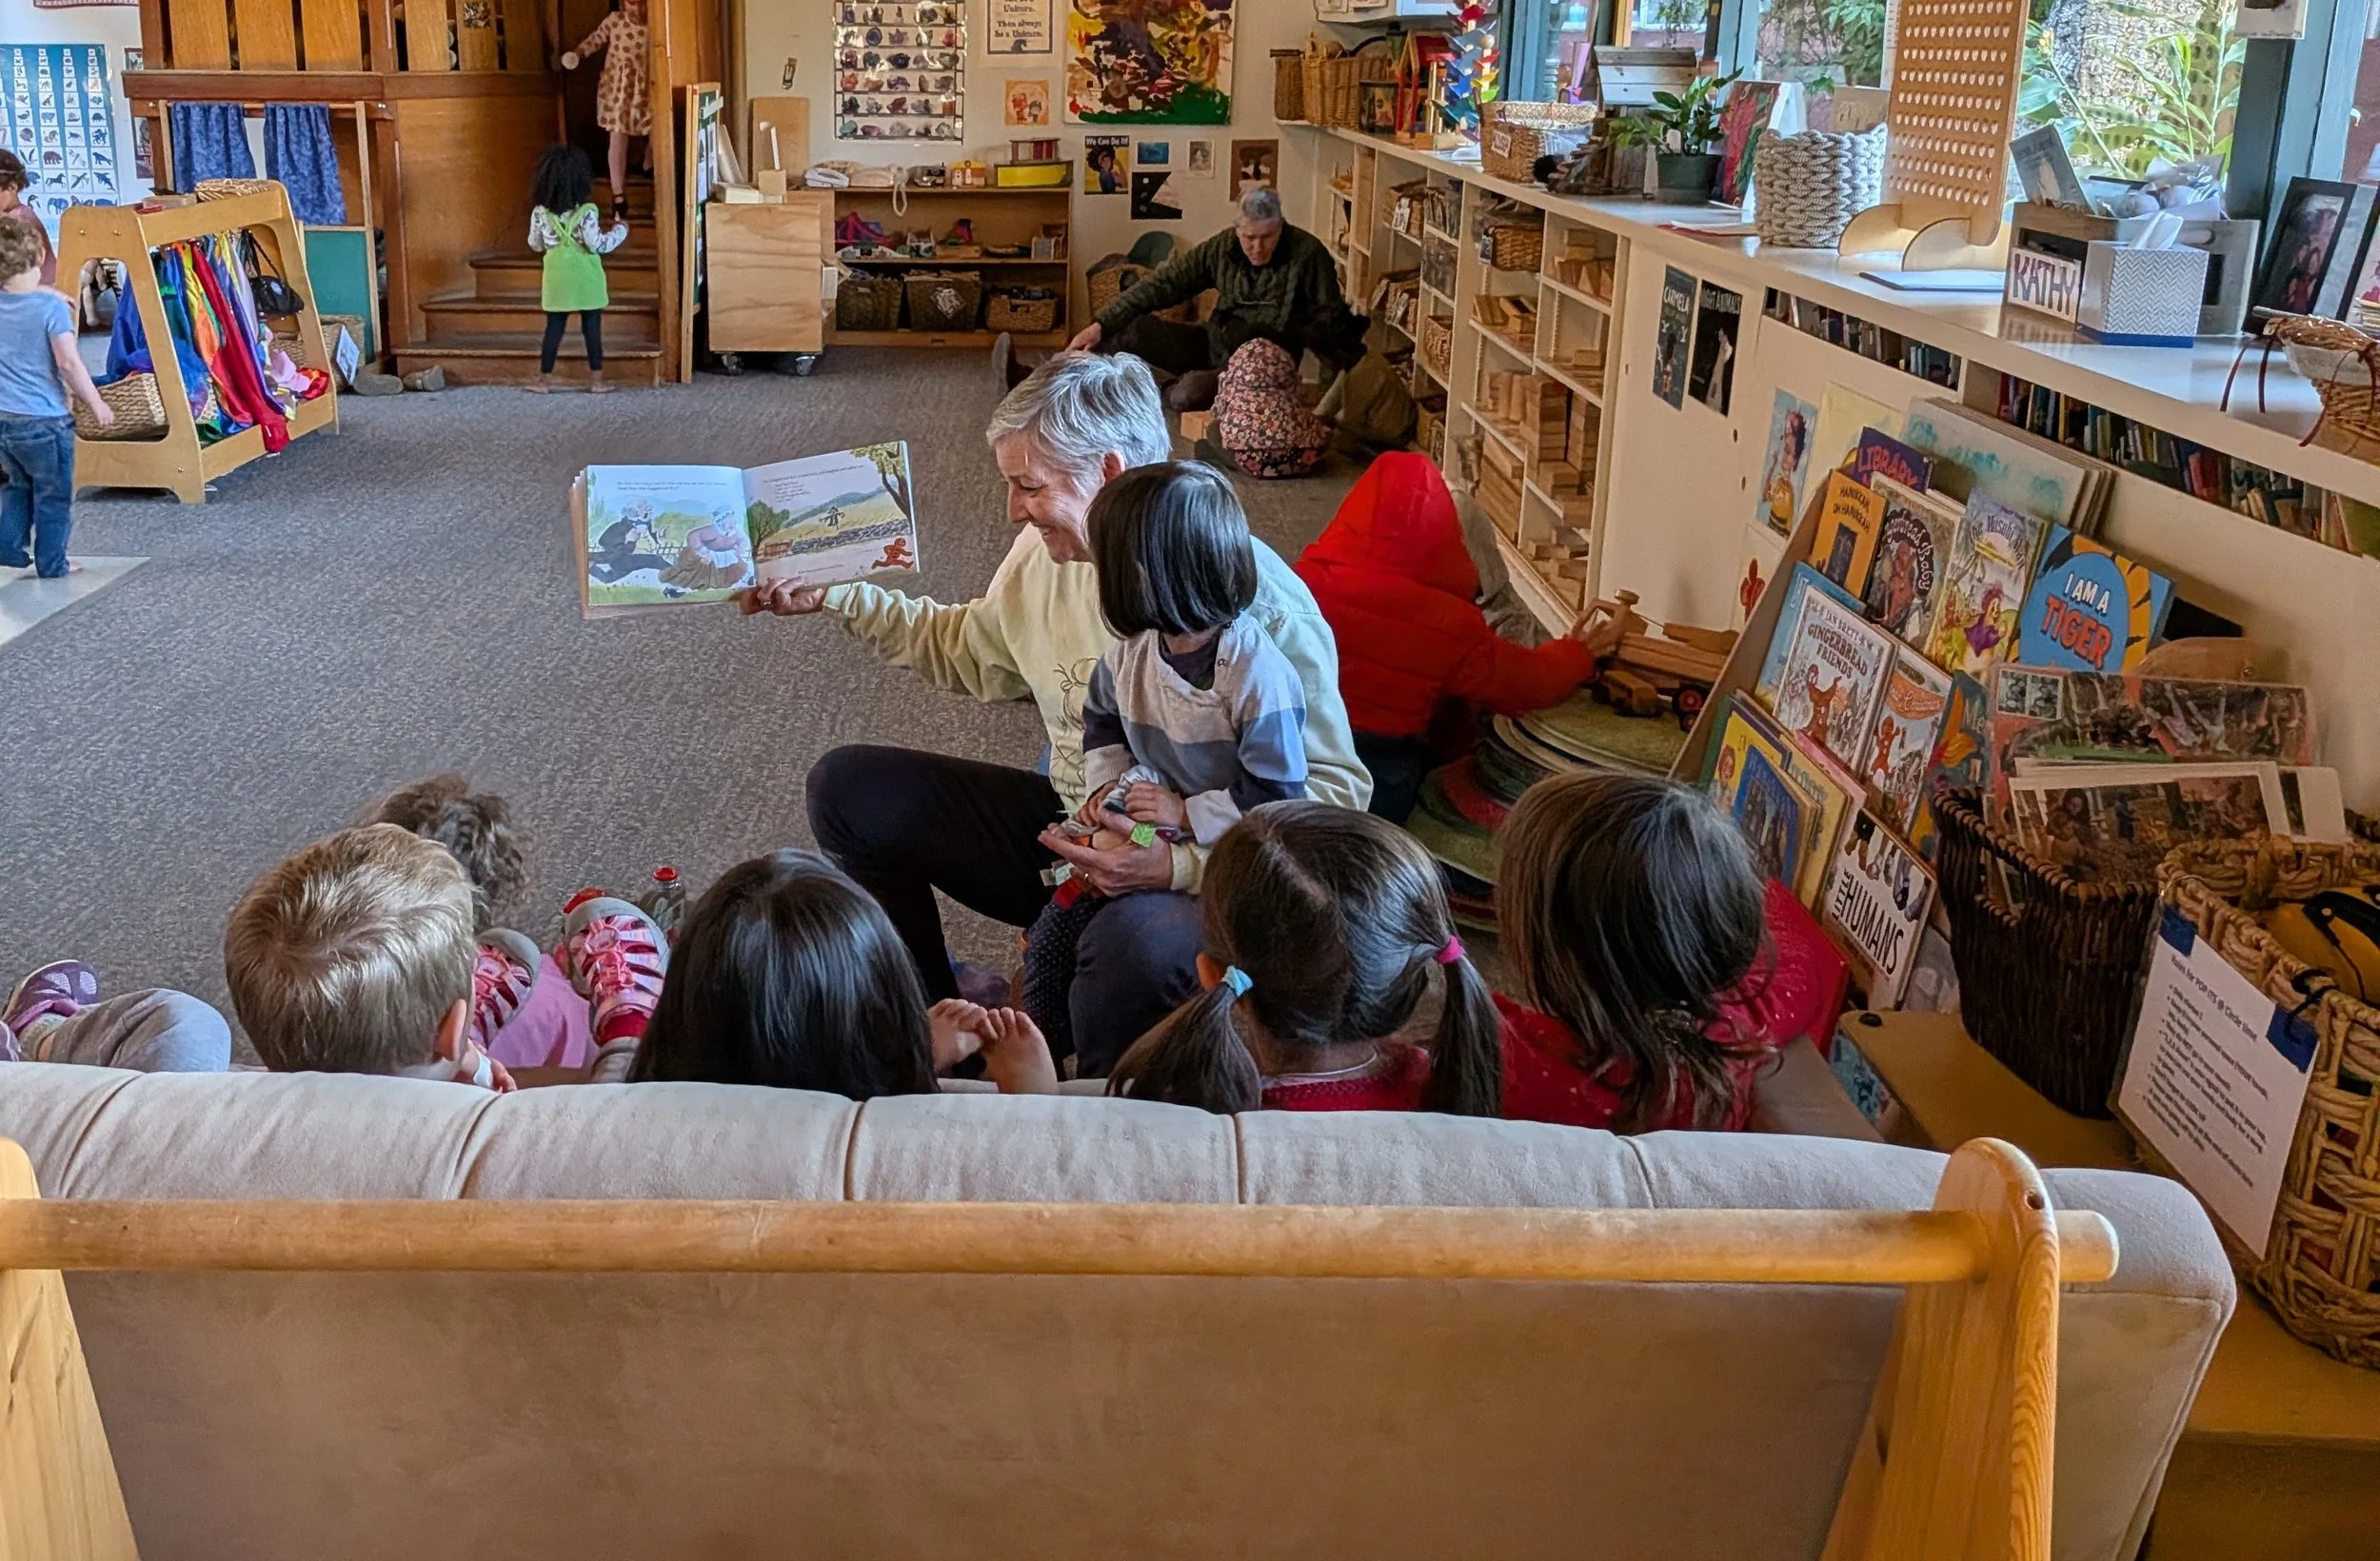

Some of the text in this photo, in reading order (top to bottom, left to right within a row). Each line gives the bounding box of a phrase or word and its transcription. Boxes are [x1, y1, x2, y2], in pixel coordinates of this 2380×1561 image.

[1018, 19, 1042, 29] always
[1085, 137, 1097, 146] We
[1098, 137, 1110, 146] Can
[1111, 136, 1121, 146] Do
[1663, 286, 1690, 315] CARMELA
[2013, 252, 2077, 316] KATHY
[1857, 445, 1919, 485] LIBRARY
[1916, 541, 1934, 591] Baby
[2064, 572, 2112, 616] I AM A
[1825, 610, 1859, 642] JAN BRETT
[2041, 593, 2112, 670] TIGER
[1808, 623, 1867, 676] GINGERBREAD
[1816, 643, 1854, 680] FRIENDS
[1832, 868, 1851, 921] LITTLE
[1840, 875, 1903, 975] HUMANS
[2195, 978, 2208, 994] POP
